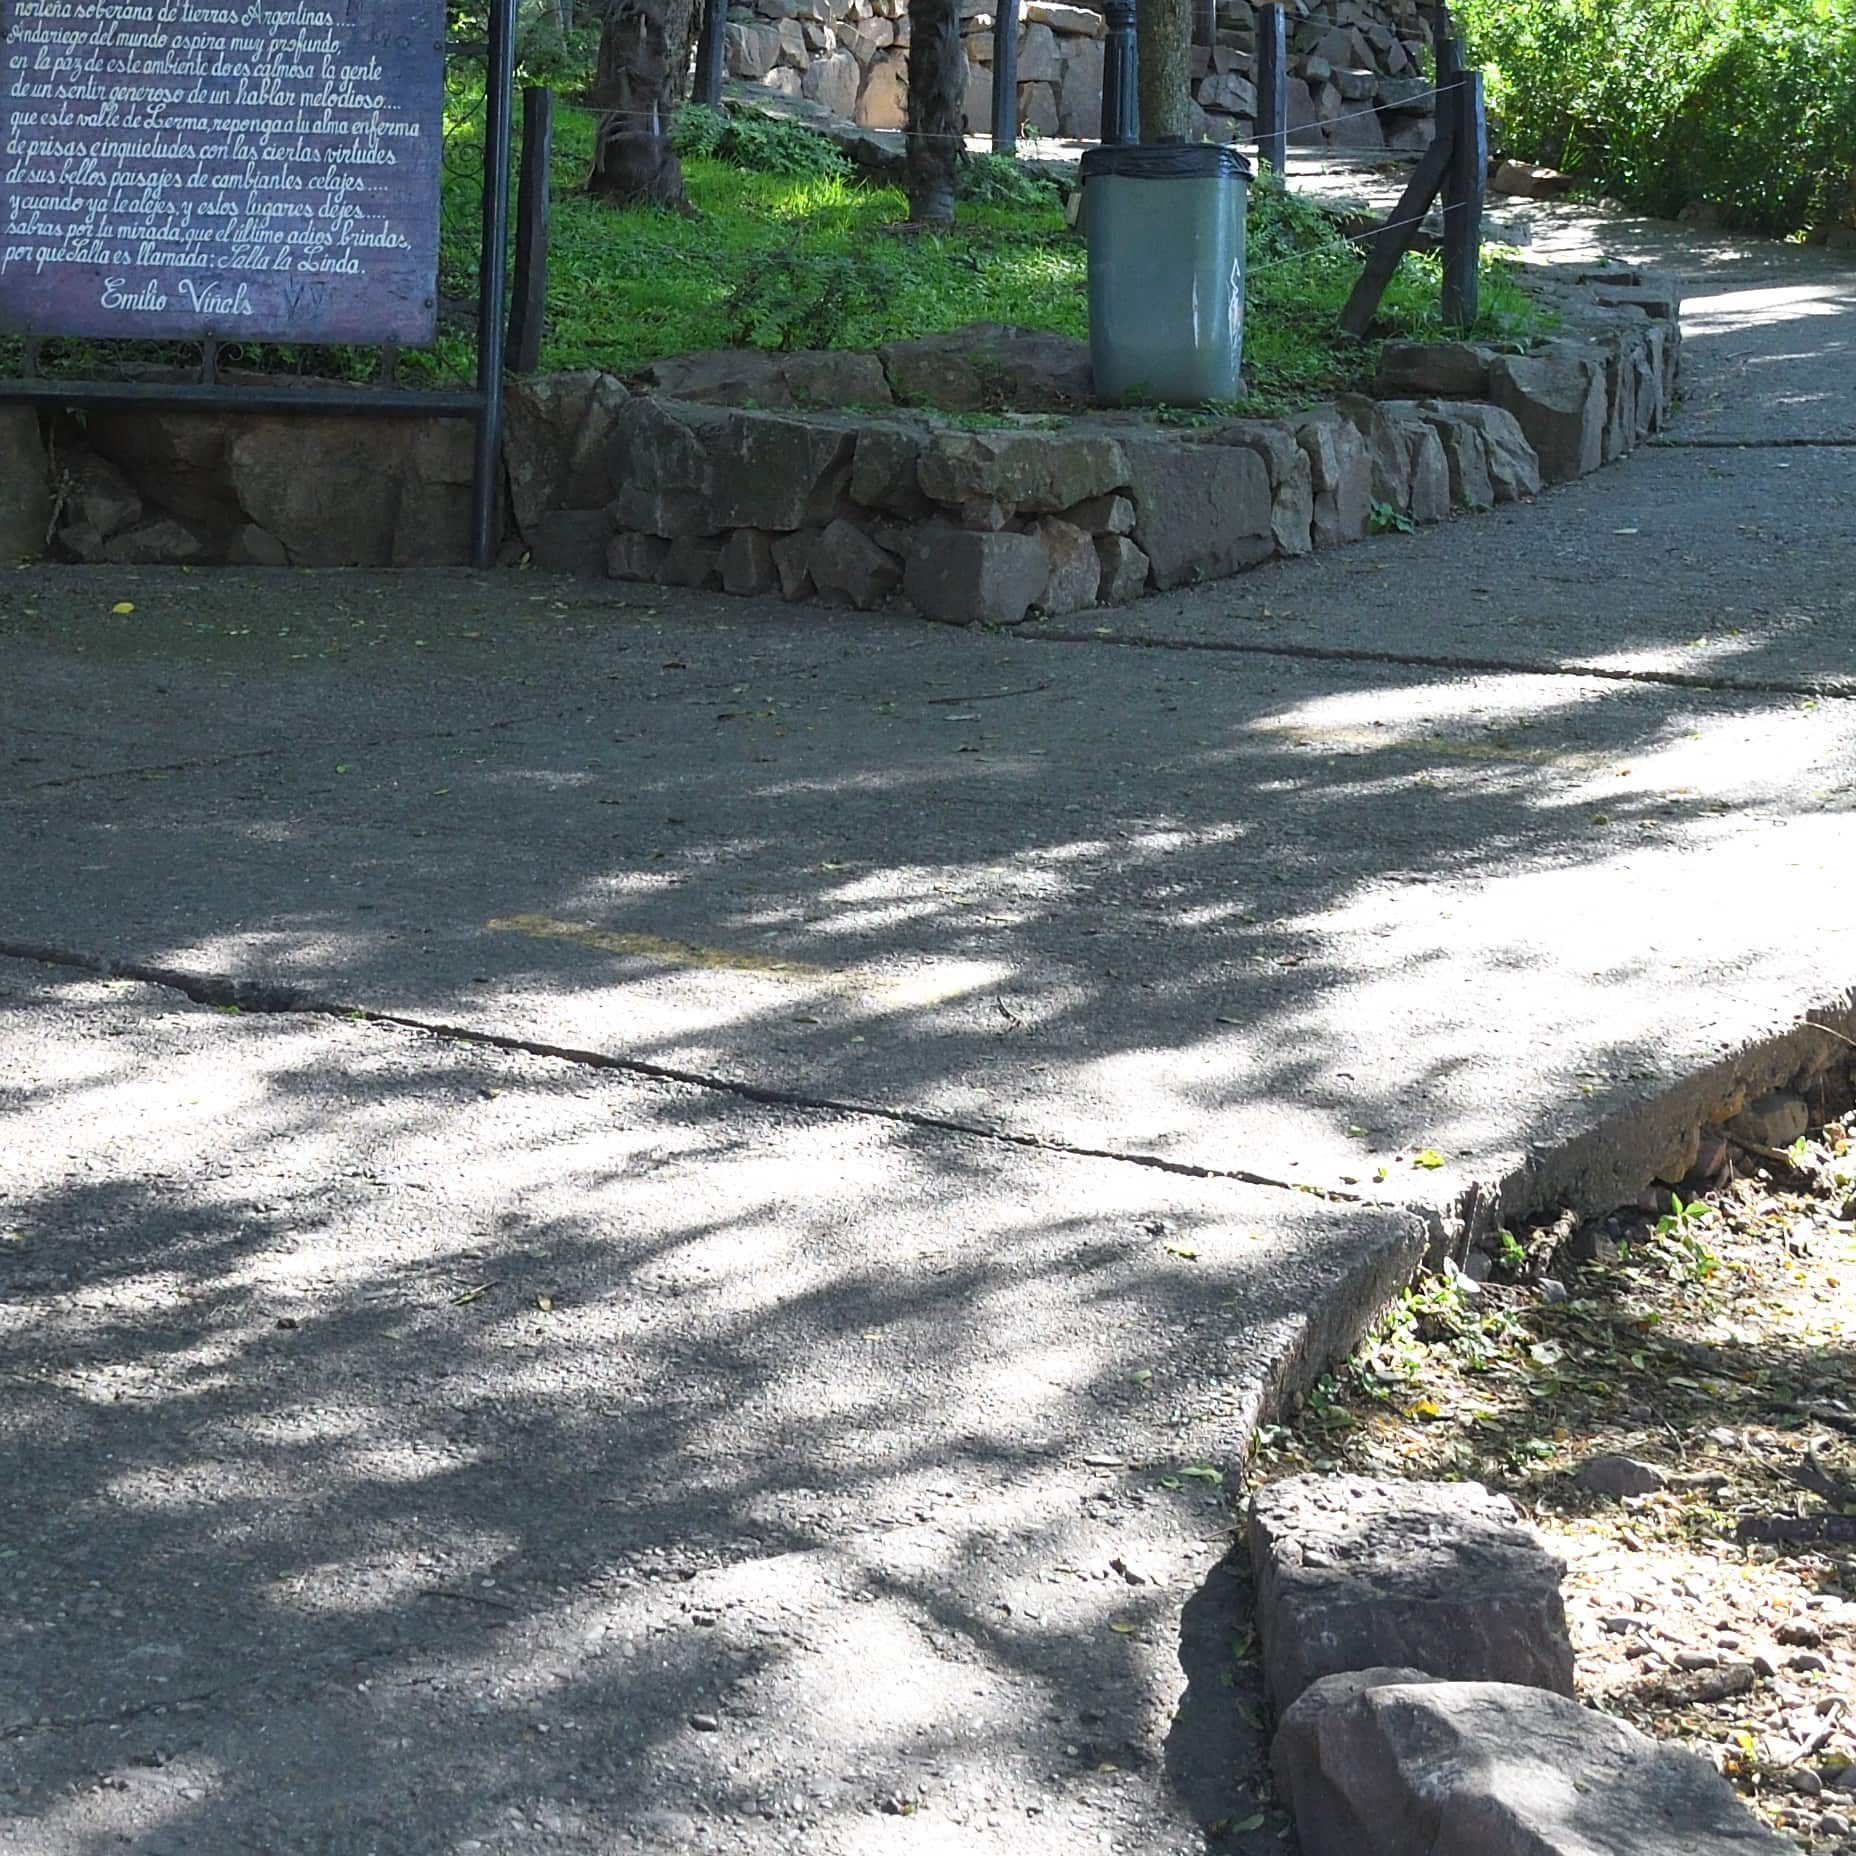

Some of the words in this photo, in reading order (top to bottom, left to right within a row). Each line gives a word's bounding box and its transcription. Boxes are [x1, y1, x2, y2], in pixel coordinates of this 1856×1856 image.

[7, 20, 88, 55] Andariego
[90, 21, 118, 46] del
[117, 23, 169, 49] mundo
[172, 32, 225, 60] aspira
[231, 36, 265, 63] muy
[51, 56, 83, 82] paz
[107, 49, 142, 74] este
[145, 49, 210, 76] ambiente
[254, 52, 315, 79] calmosa
[340, 55, 383, 91] gente
[54, 75, 107, 100] sentir
[109, 84, 185, 108] generoso
[235, 78, 296, 106] hablar
[11, 110, 38, 136] que
[41, 101, 74, 126] este
[77, 101, 120, 128] valle
[213, 118, 282, 145] reponga
[312, 108, 351, 134] alma
[352, 111, 420, 148] enferma
[25, 136, 88, 166] prisas
[200, 145, 228, 160] con
[233, 134, 259, 161] las
[262, 136, 322, 162] ciertas
[325, 137, 397, 164] virtudes
[29, 168, 56, 184] sus
[59, 157, 107, 186] bellos
[109, 167, 183, 199] paisajes
[212, 161, 303, 191] cambiantes
[21, 186, 83, 212] cuando
[198, 190, 240, 217] estos
[246, 190, 315, 229] lugares
[6, 211, 63, 237] sabras
[66, 222, 94, 246] por
[186, 228, 214, 250] que
[234, 217, 284, 246] último
[288, 220, 333, 247] adios
[1, 245, 33, 276] por
[36, 245, 64, 275] que
[66, 238, 113, 265] Salta
[218, 244, 268, 271] Salta
[101, 276, 169, 312] Emilio
